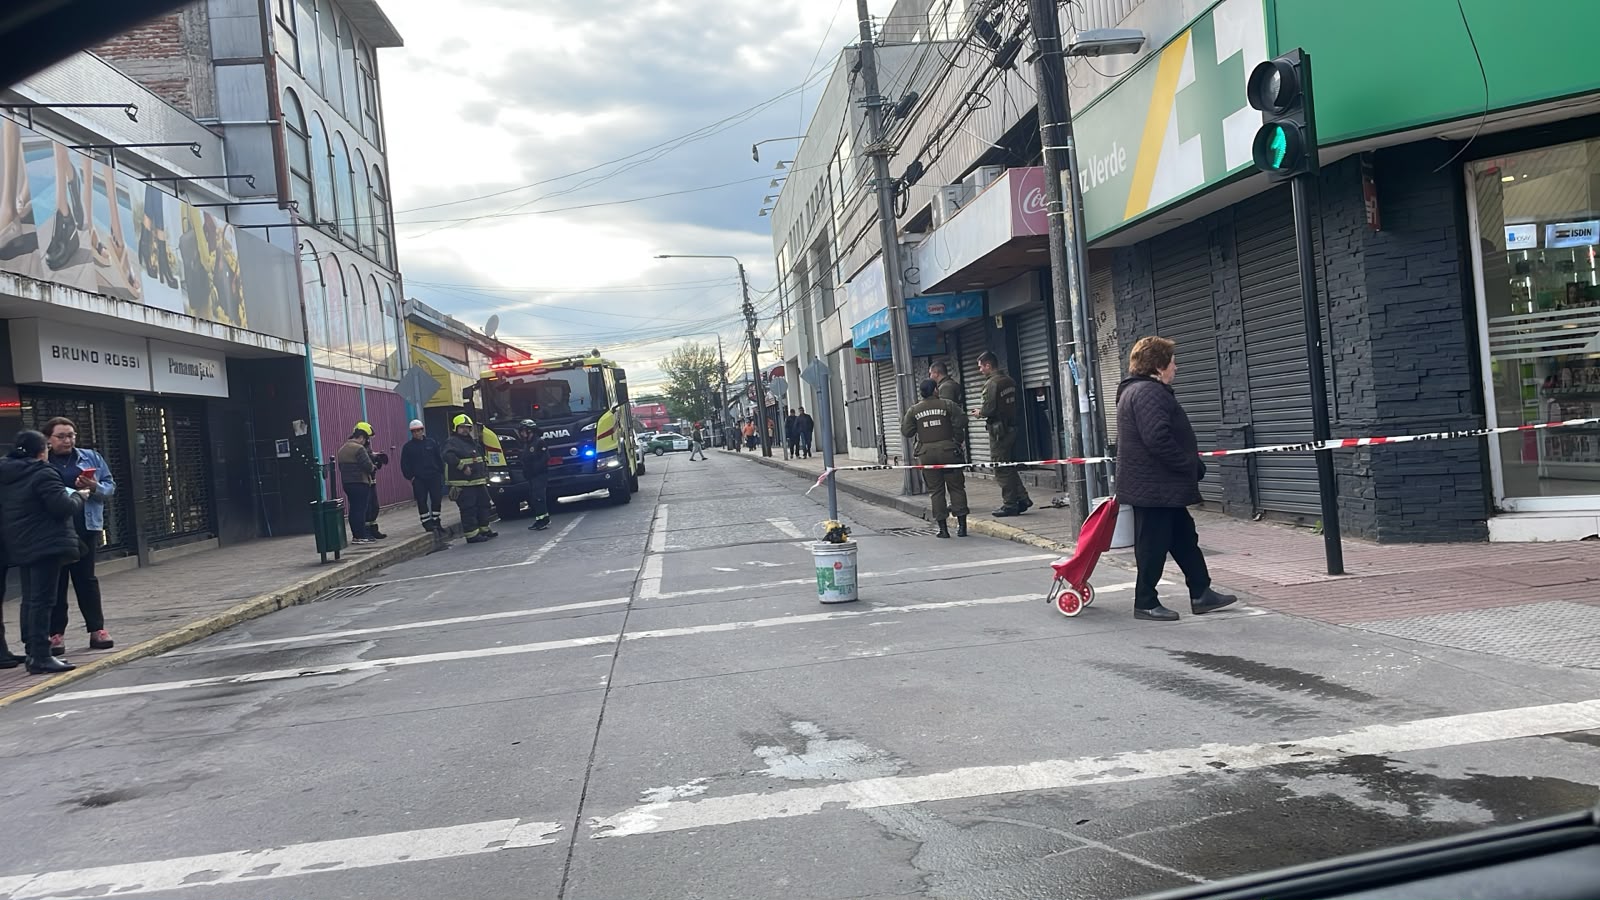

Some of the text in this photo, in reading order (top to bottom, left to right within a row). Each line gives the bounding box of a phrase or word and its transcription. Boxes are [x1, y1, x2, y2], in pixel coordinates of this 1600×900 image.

[1088, 141, 1127, 189] Verde
[1571, 228, 1592, 237] ISDIN
[52, 345, 140, 369] BRUNO ROSSI
[168, 357, 199, 377] Panama
